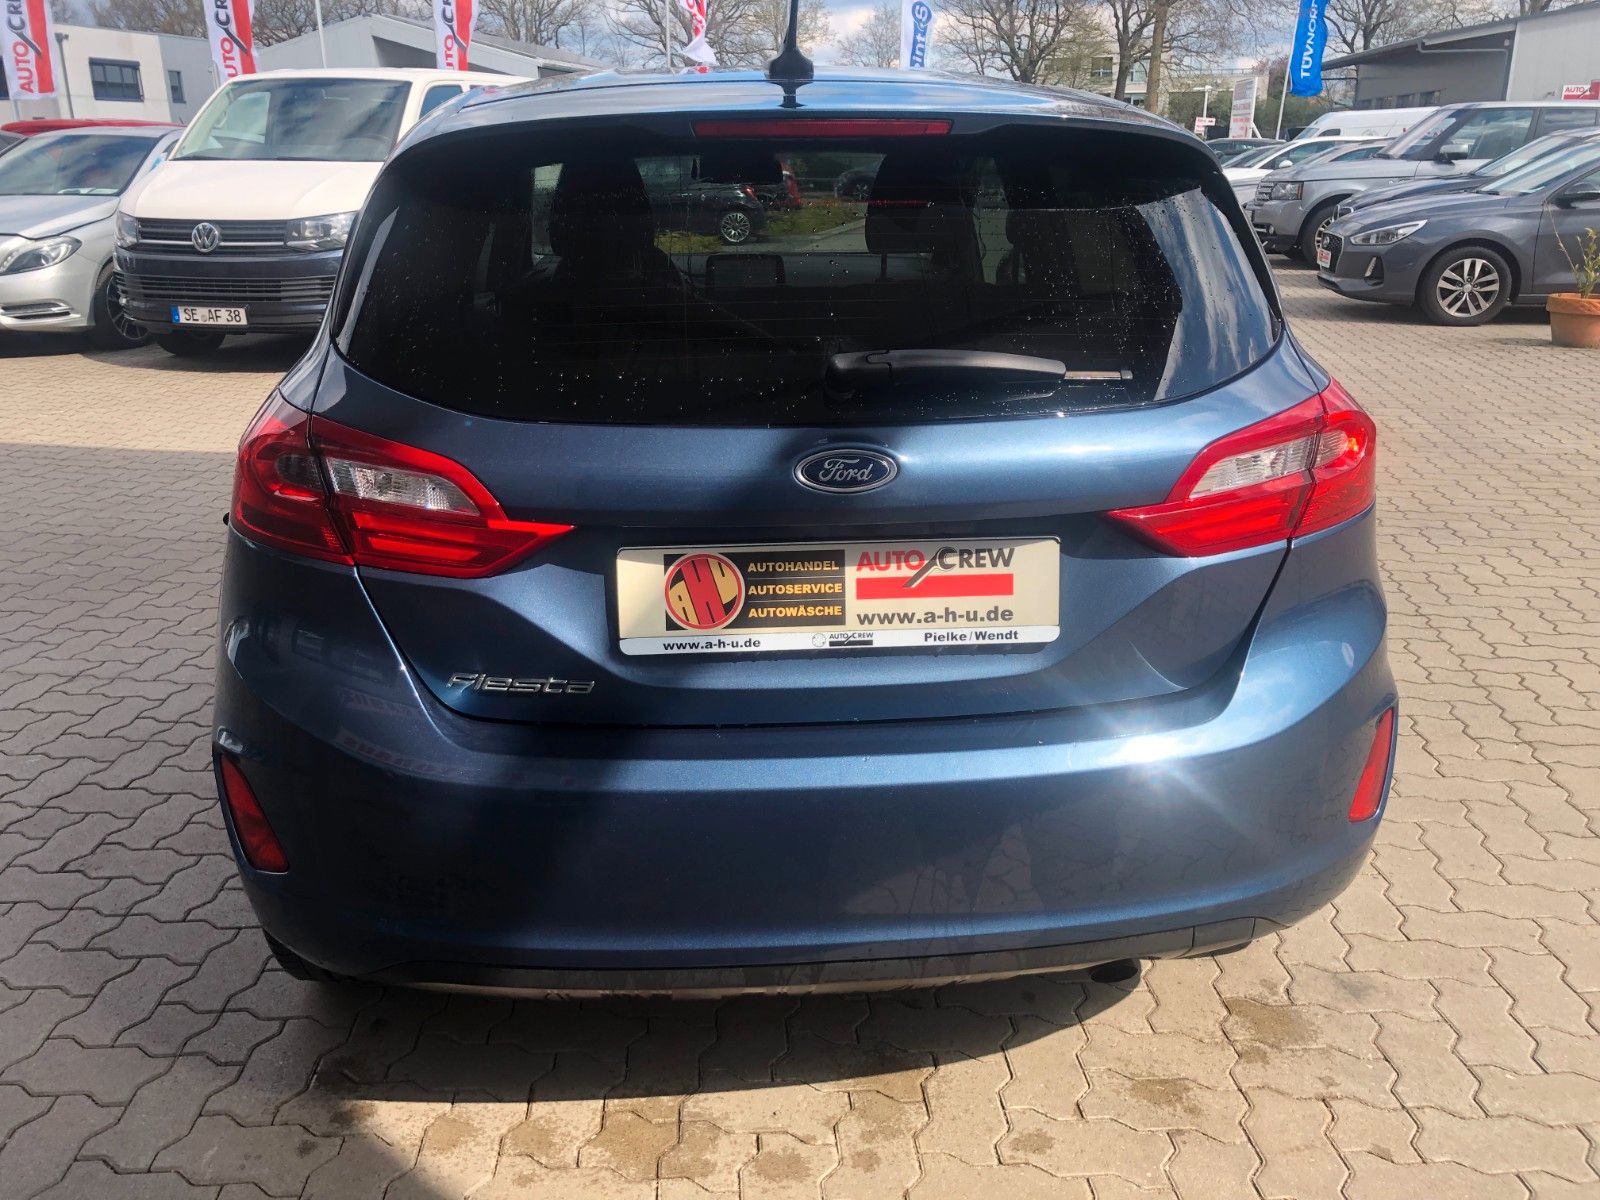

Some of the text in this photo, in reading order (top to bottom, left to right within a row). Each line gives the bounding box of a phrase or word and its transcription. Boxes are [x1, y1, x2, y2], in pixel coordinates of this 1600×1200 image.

[6, 0, 34, 93] AUTO CR
[214, 0, 238, 78] UTO CR
[183, 308, 242, 323] SE AF 38
[818, 458, 874, 481] Ford
[747, 560, 840, 573] AUTOHANDEL
[855, 546, 1016, 572] AUTO CREW
[747, 583, 843, 595] AUTOSERVICE
[748, 605, 843, 618] AUTOWÄSCHE
[856, 605, 1014, 626] www.a-h-u.de
[663, 637, 762, 651] www.a-h-u.de
[851, 631, 874, 639] CREW
[446, 672, 595, 694] Fiesta
